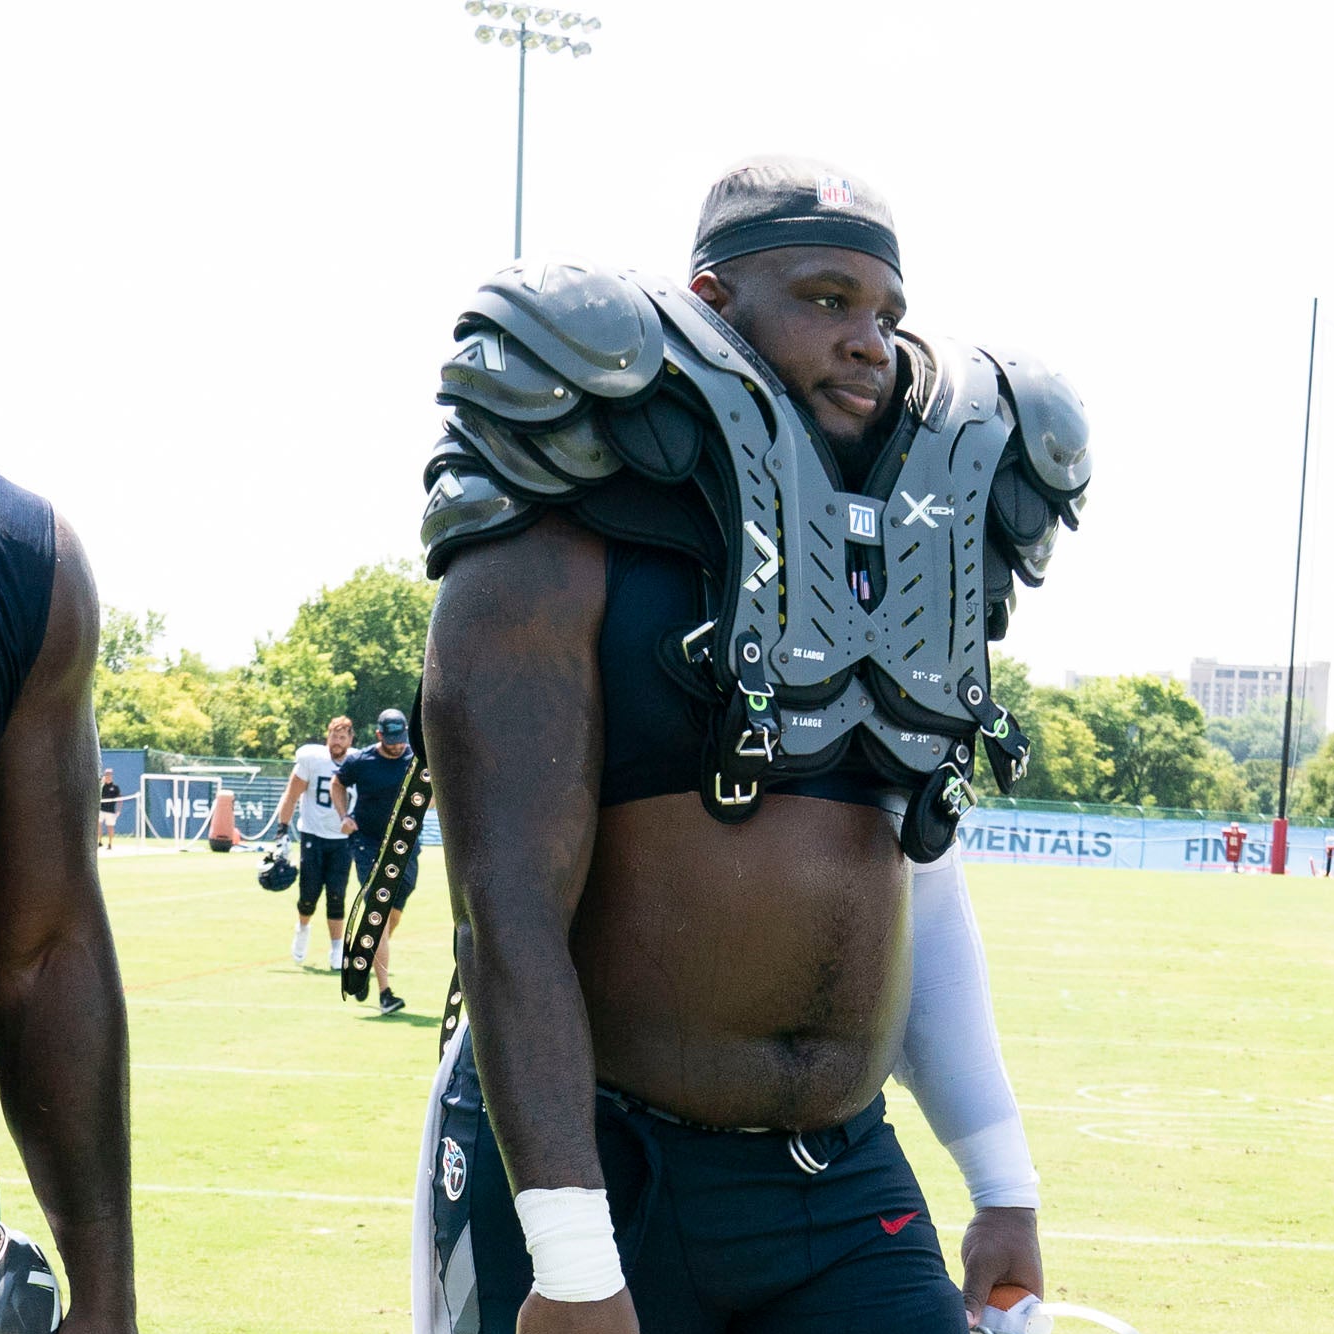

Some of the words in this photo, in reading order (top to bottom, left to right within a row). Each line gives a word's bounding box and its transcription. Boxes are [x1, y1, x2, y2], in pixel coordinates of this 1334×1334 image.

[851, 507, 873, 535] 70
[803, 649, 825, 661] LARGE
[799, 717, 822, 728] LARGE
[166, 798, 263, 820] NISAN
